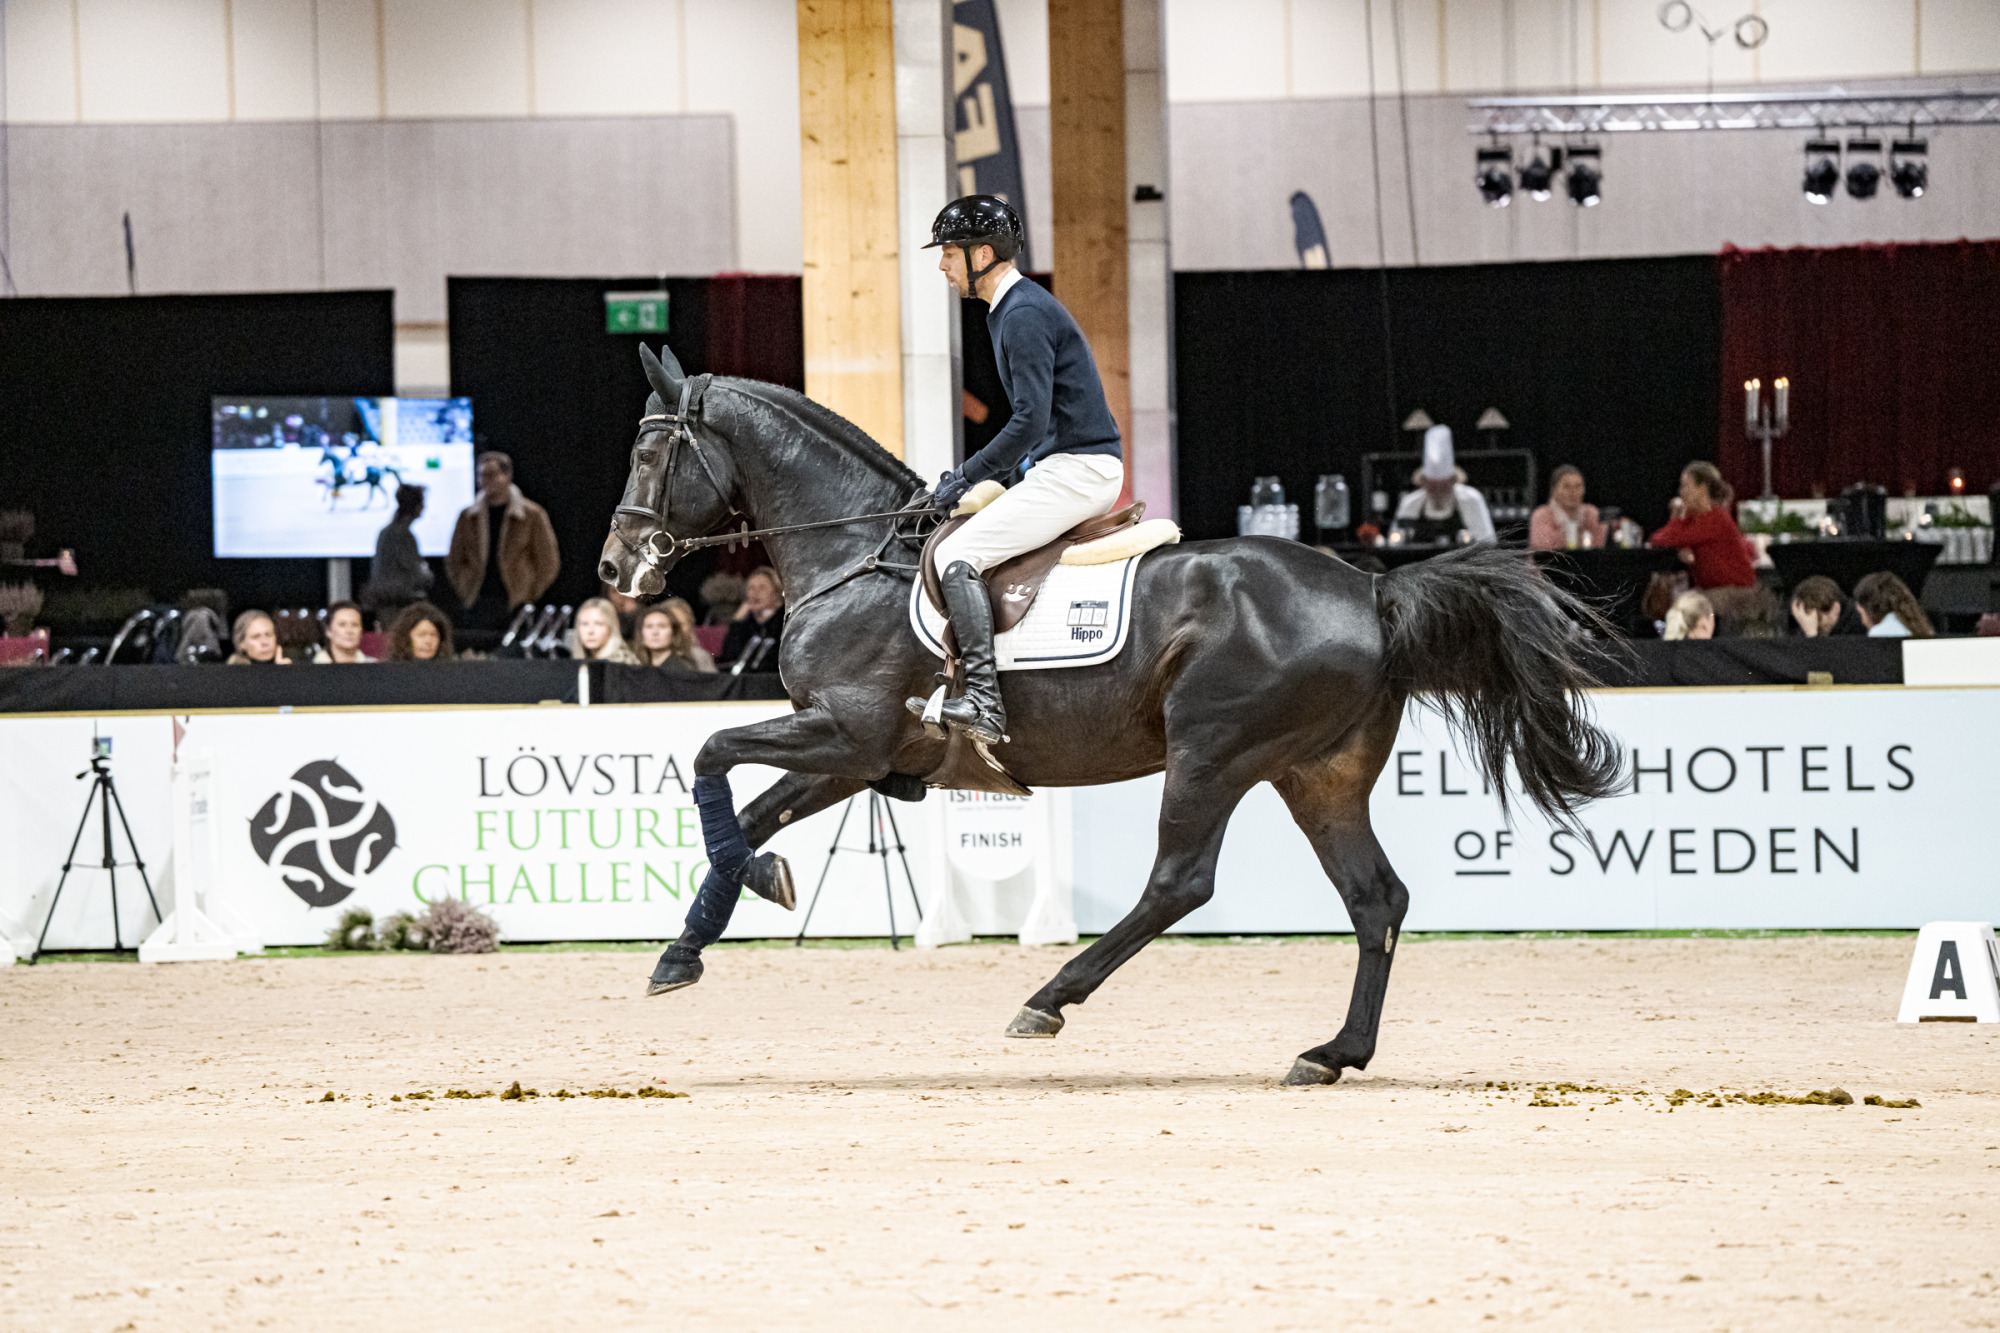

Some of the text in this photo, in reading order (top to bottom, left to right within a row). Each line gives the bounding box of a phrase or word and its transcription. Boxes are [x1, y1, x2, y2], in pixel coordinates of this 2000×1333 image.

[1071, 627, 1103, 643] Hippo
[477, 746, 692, 797] LÖVSTA
[1633, 744, 1915, 795] HOTELS
[475, 807, 698, 852] FUTURE
[961, 832, 1022, 847] FINISH
[1454, 827, 1859, 875] OF SWEDEN
[412, 860, 760, 904] CHALLEN
[1928, 940, 1967, 1000] A
